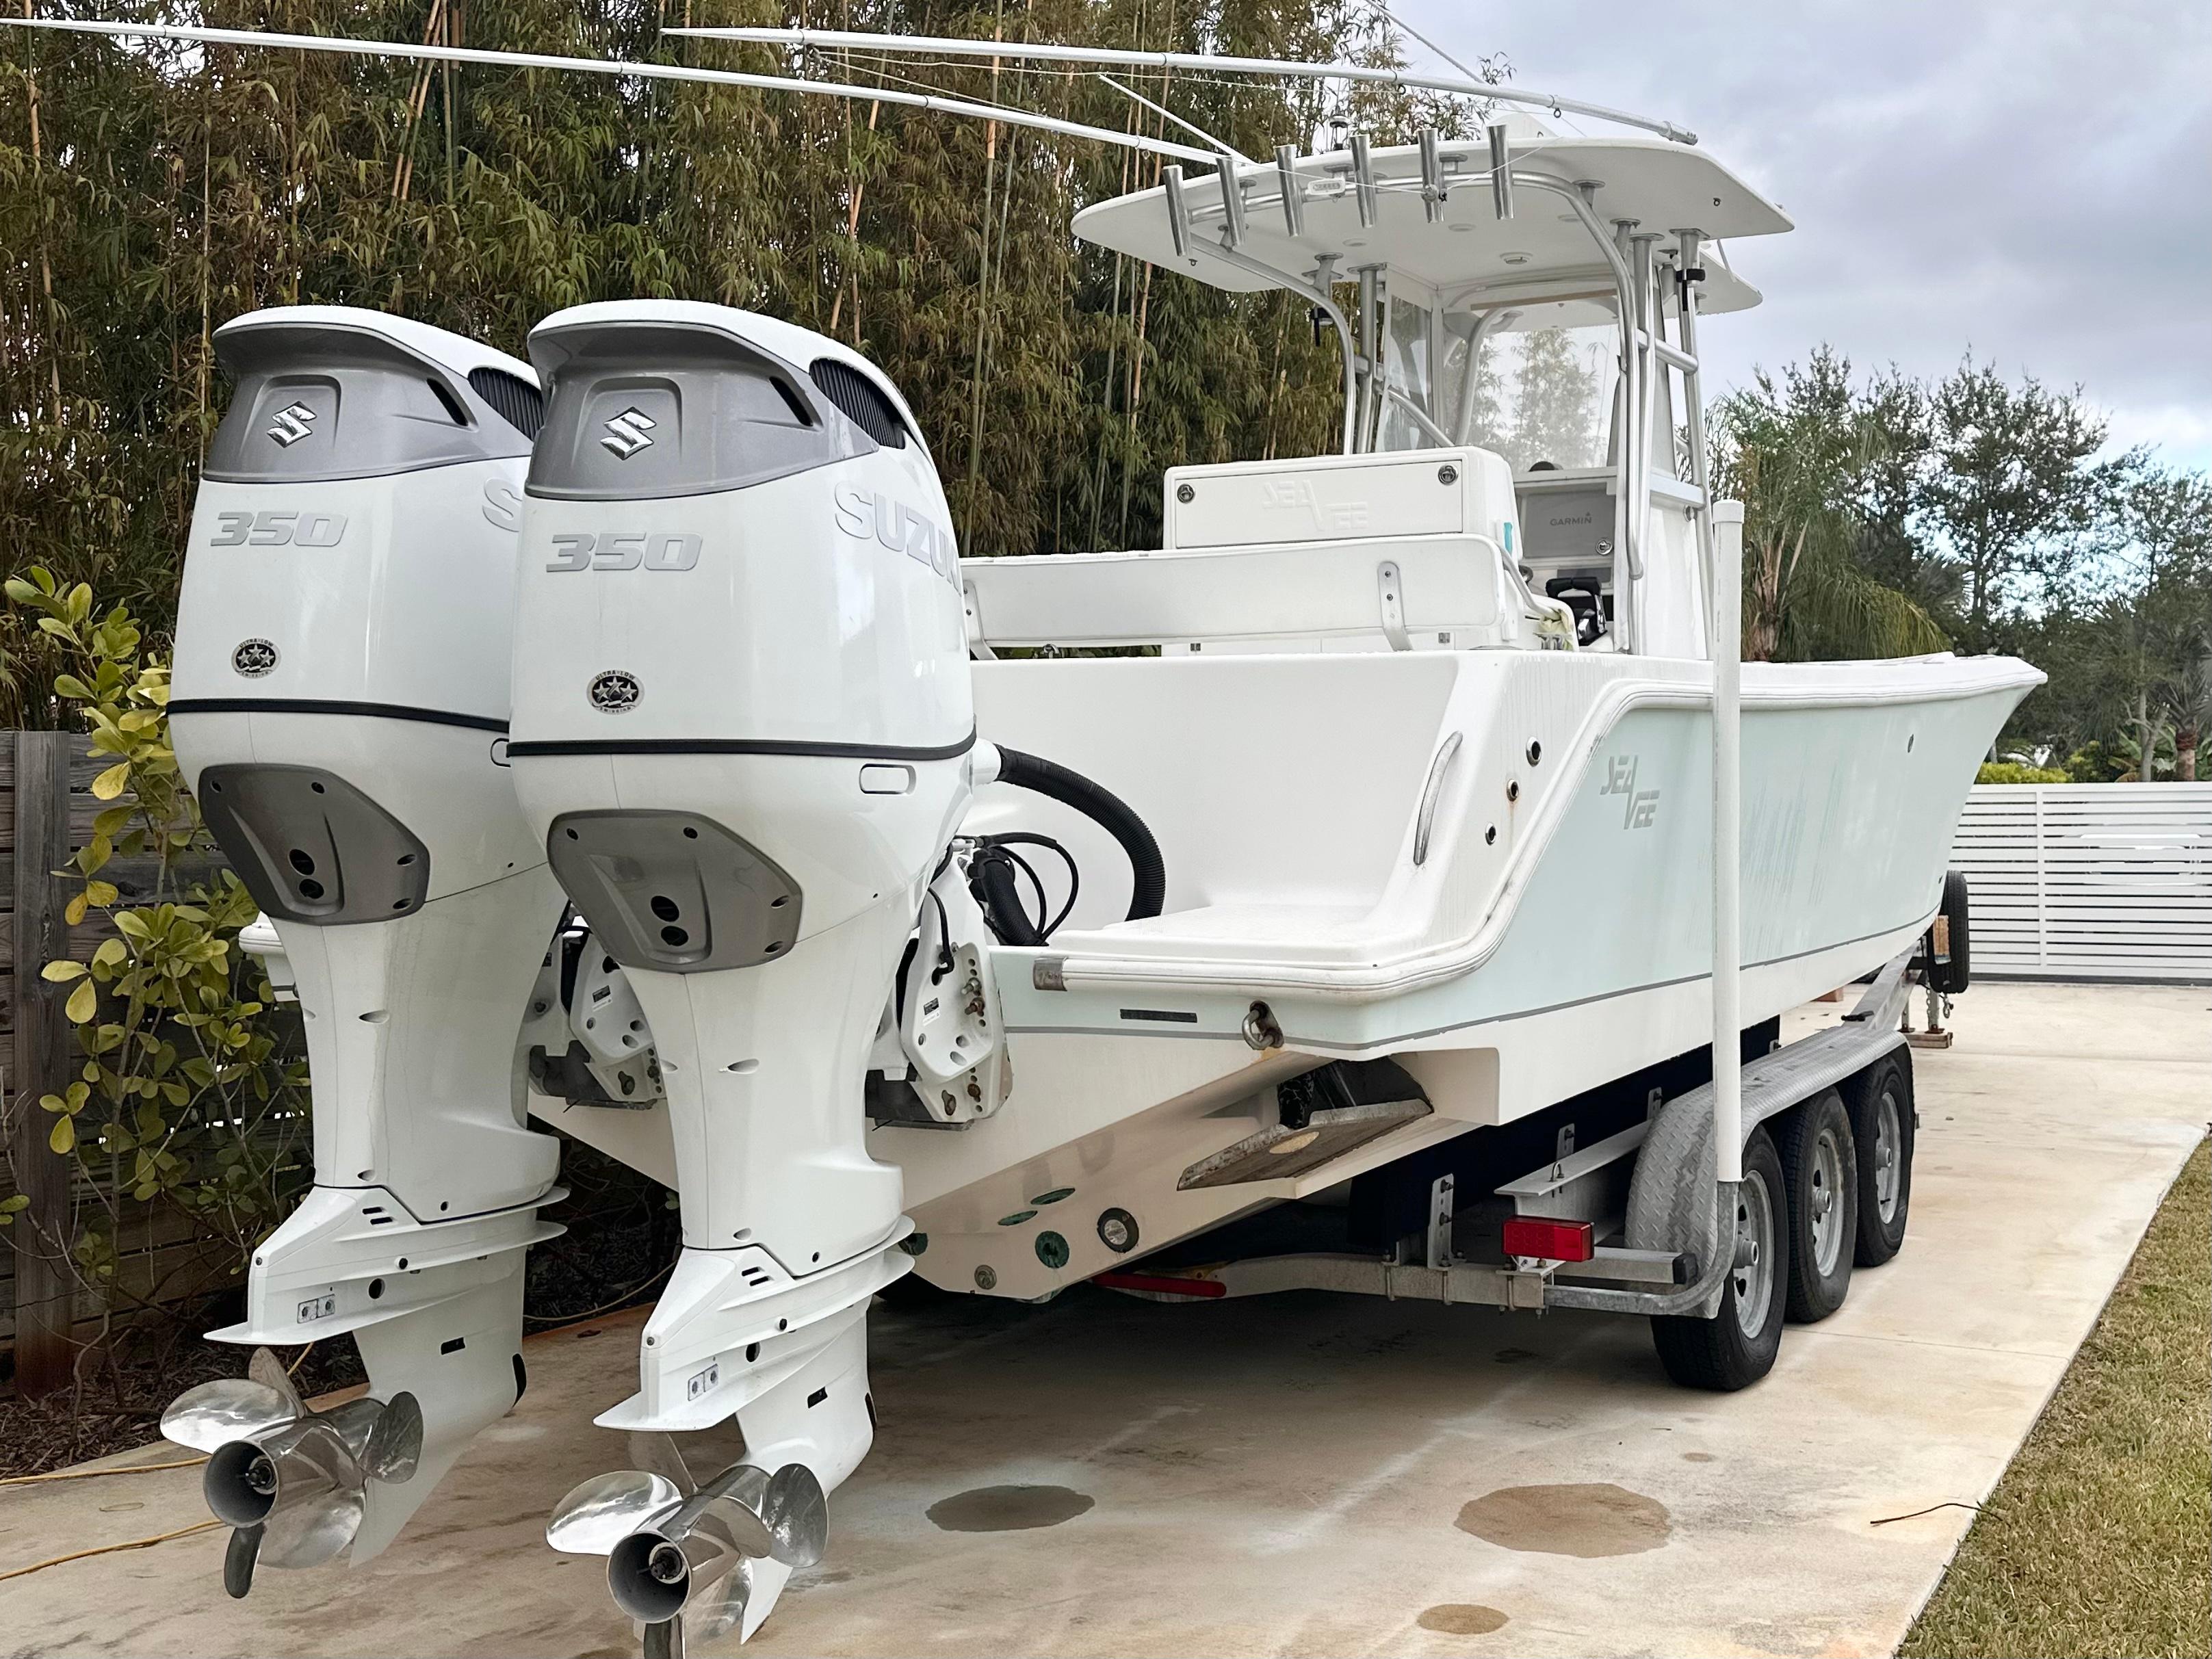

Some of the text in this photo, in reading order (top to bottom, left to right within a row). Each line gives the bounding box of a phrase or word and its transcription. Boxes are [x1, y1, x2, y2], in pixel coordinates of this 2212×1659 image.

[211, 512, 348, 547] 350
[1550, 516, 1592, 526] GARMIN
[547, 532, 703, 573] 350
[1600, 755, 1638, 795] SEA
[1624, 790, 1660, 830] VEE
